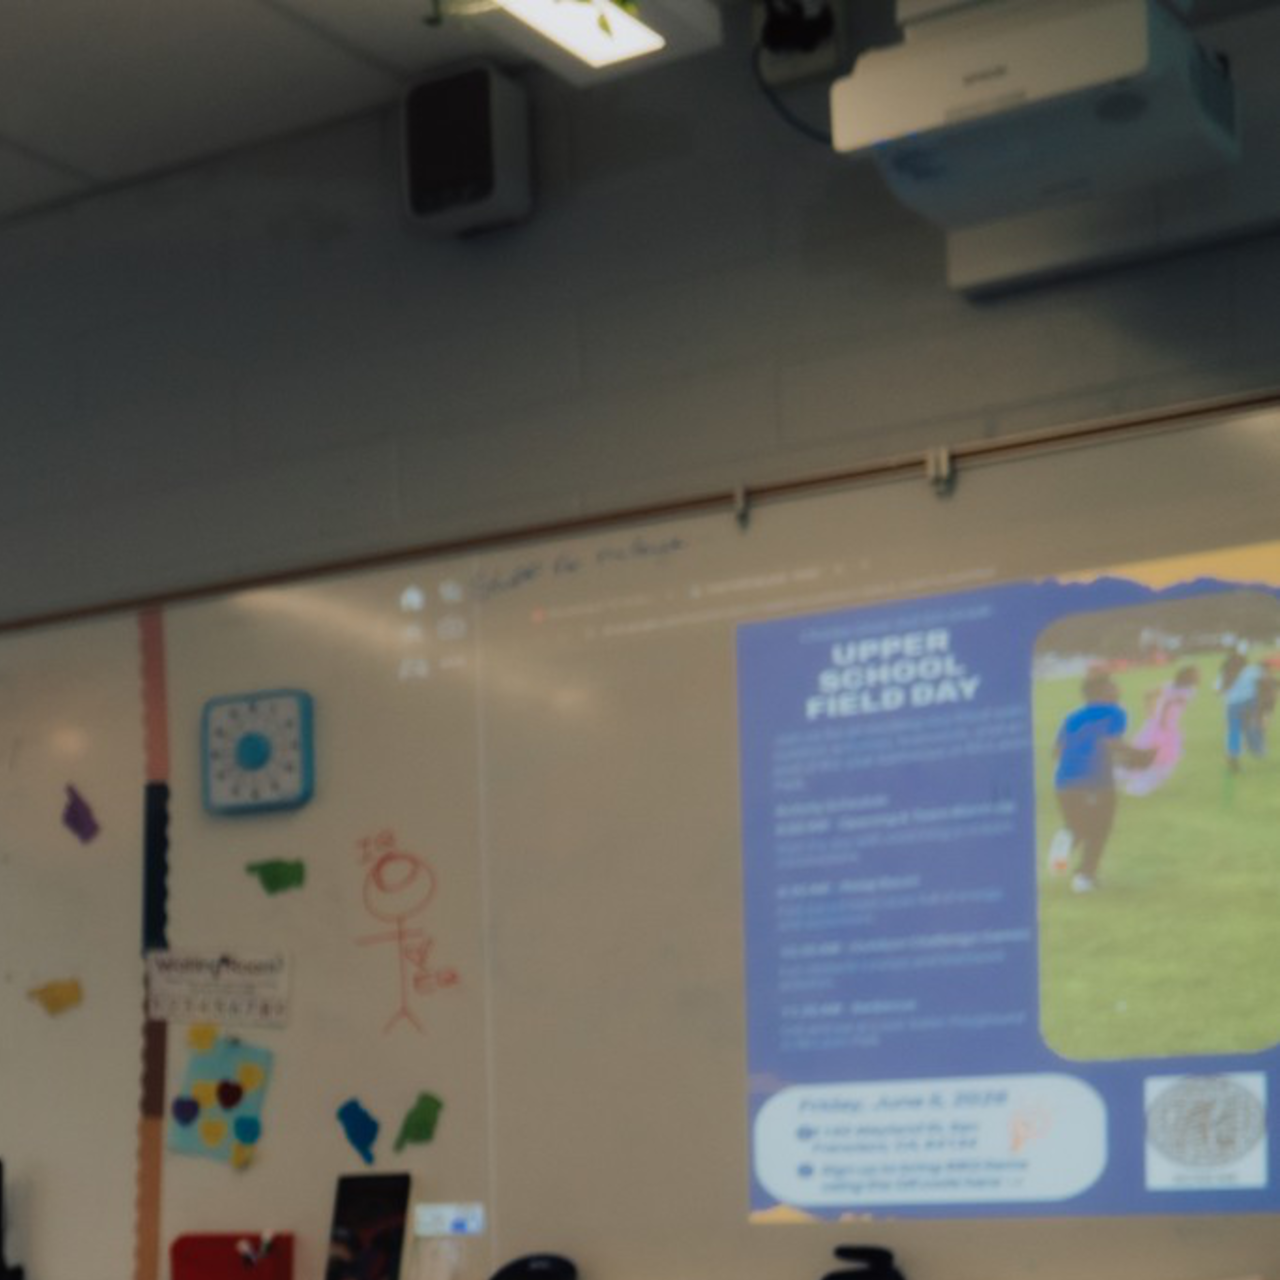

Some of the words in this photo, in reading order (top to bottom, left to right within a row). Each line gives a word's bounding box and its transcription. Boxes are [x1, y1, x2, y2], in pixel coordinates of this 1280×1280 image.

[831, 626, 950, 667] UPPER
[818, 653, 966, 694] SCHOOL
[804, 686, 906, 721] FIELD
[909, 675, 981, 709] DAY
